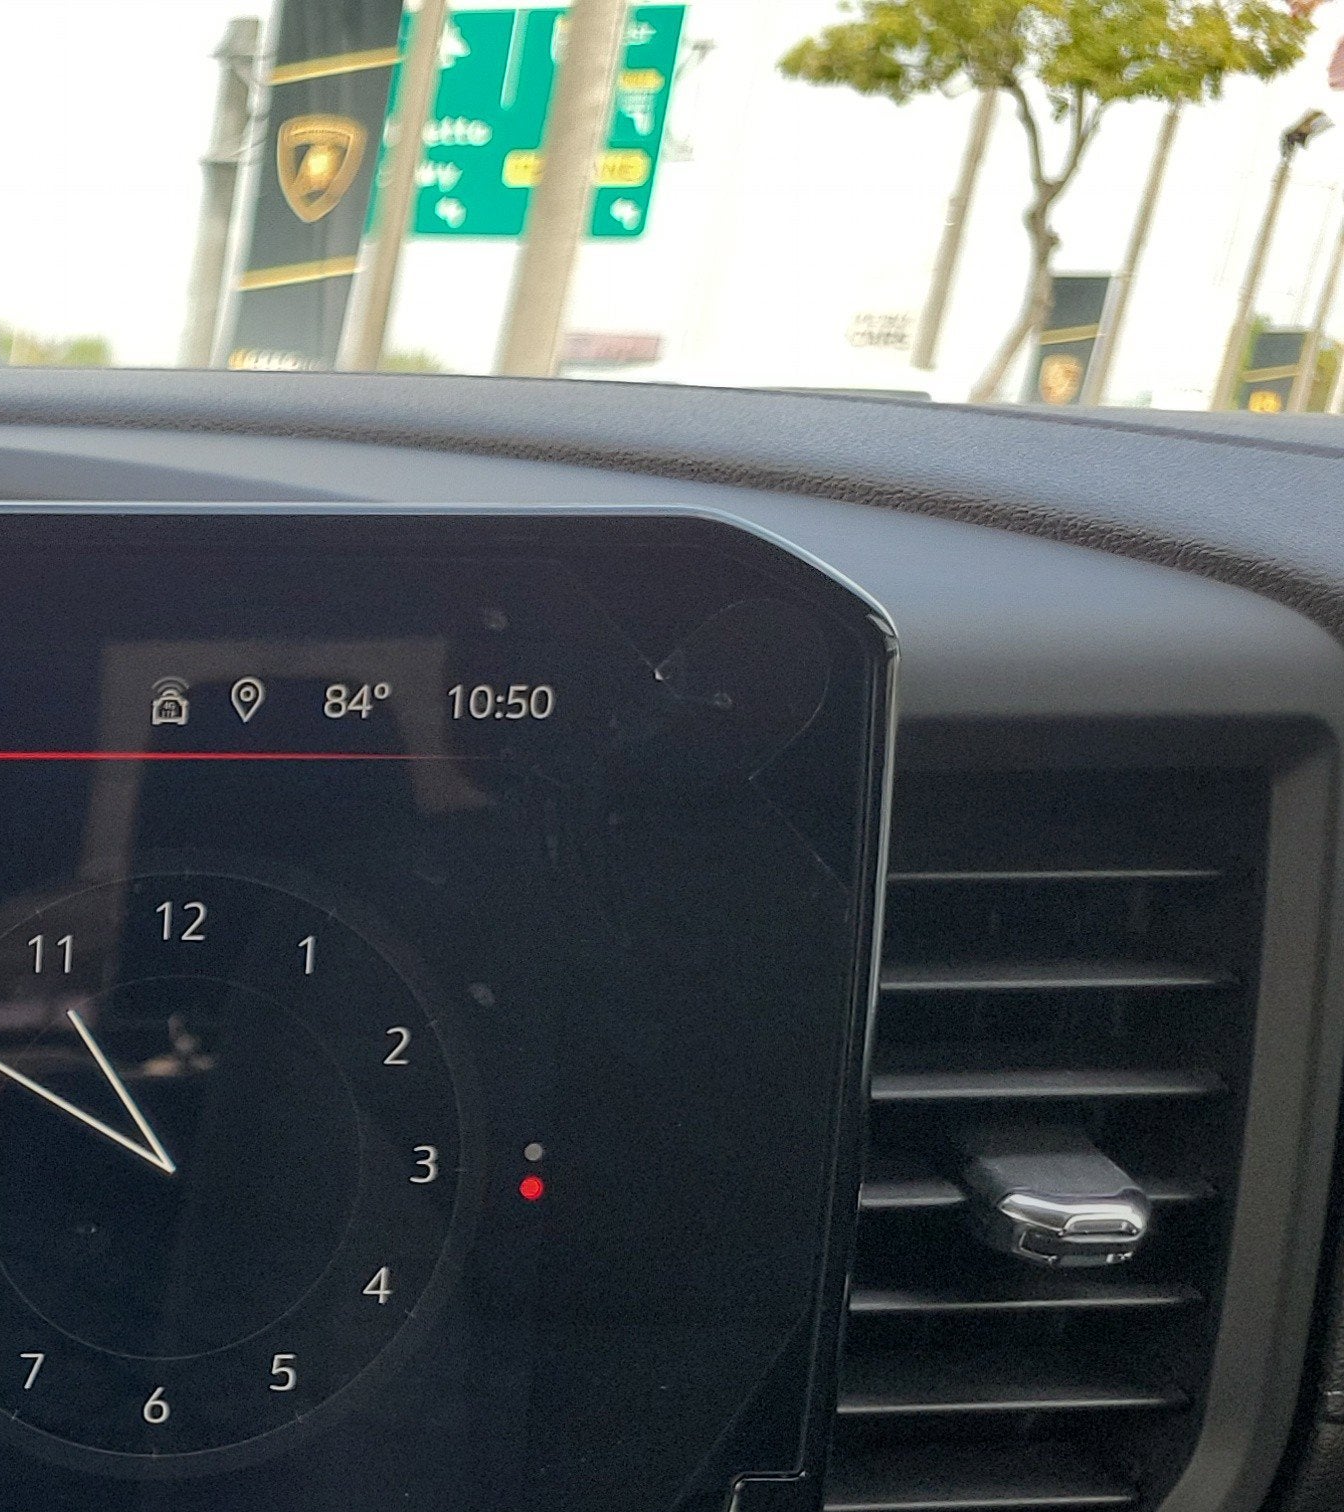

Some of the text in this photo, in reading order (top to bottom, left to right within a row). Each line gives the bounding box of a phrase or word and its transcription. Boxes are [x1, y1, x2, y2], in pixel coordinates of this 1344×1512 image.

[448, 685, 554, 719] 10:50
[156, 901, 208, 941] 12
[27, 934, 74, 974] 11
[298, 935, 316, 975] 1
[383, 1026, 411, 1065] 2
[409, 1145, 438, 1184] 3
[362, 1266, 392, 1304] 4
[20, 1353, 45, 1390] 7
[269, 1353, 296, 1391] 5
[143, 1386, 171, 1424] 6
